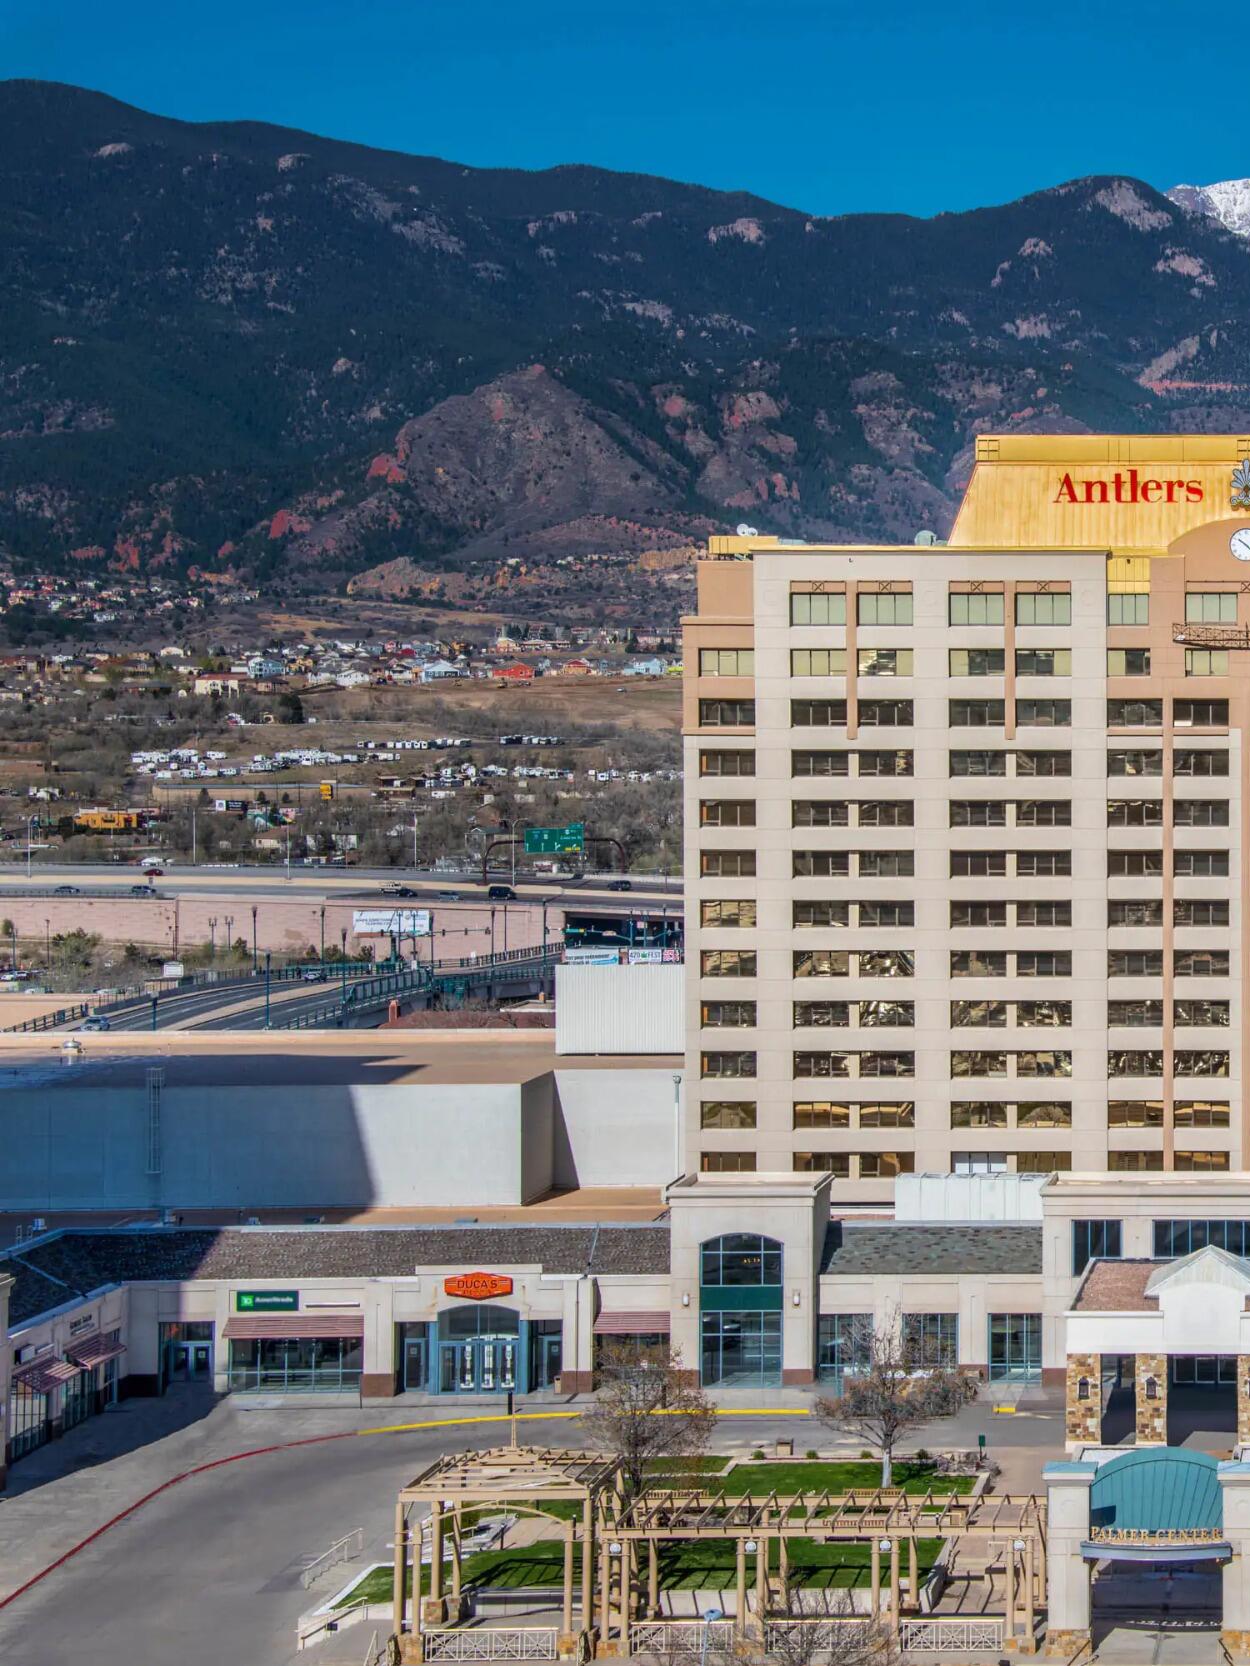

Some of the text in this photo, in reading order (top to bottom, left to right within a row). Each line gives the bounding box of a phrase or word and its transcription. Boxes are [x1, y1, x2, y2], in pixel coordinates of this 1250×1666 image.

[1053, 469, 1204, 504] Antlers
[457, 1280, 498, 1289] DUCA'S
[1091, 1526, 1222, 1542] PALMER CENTER
